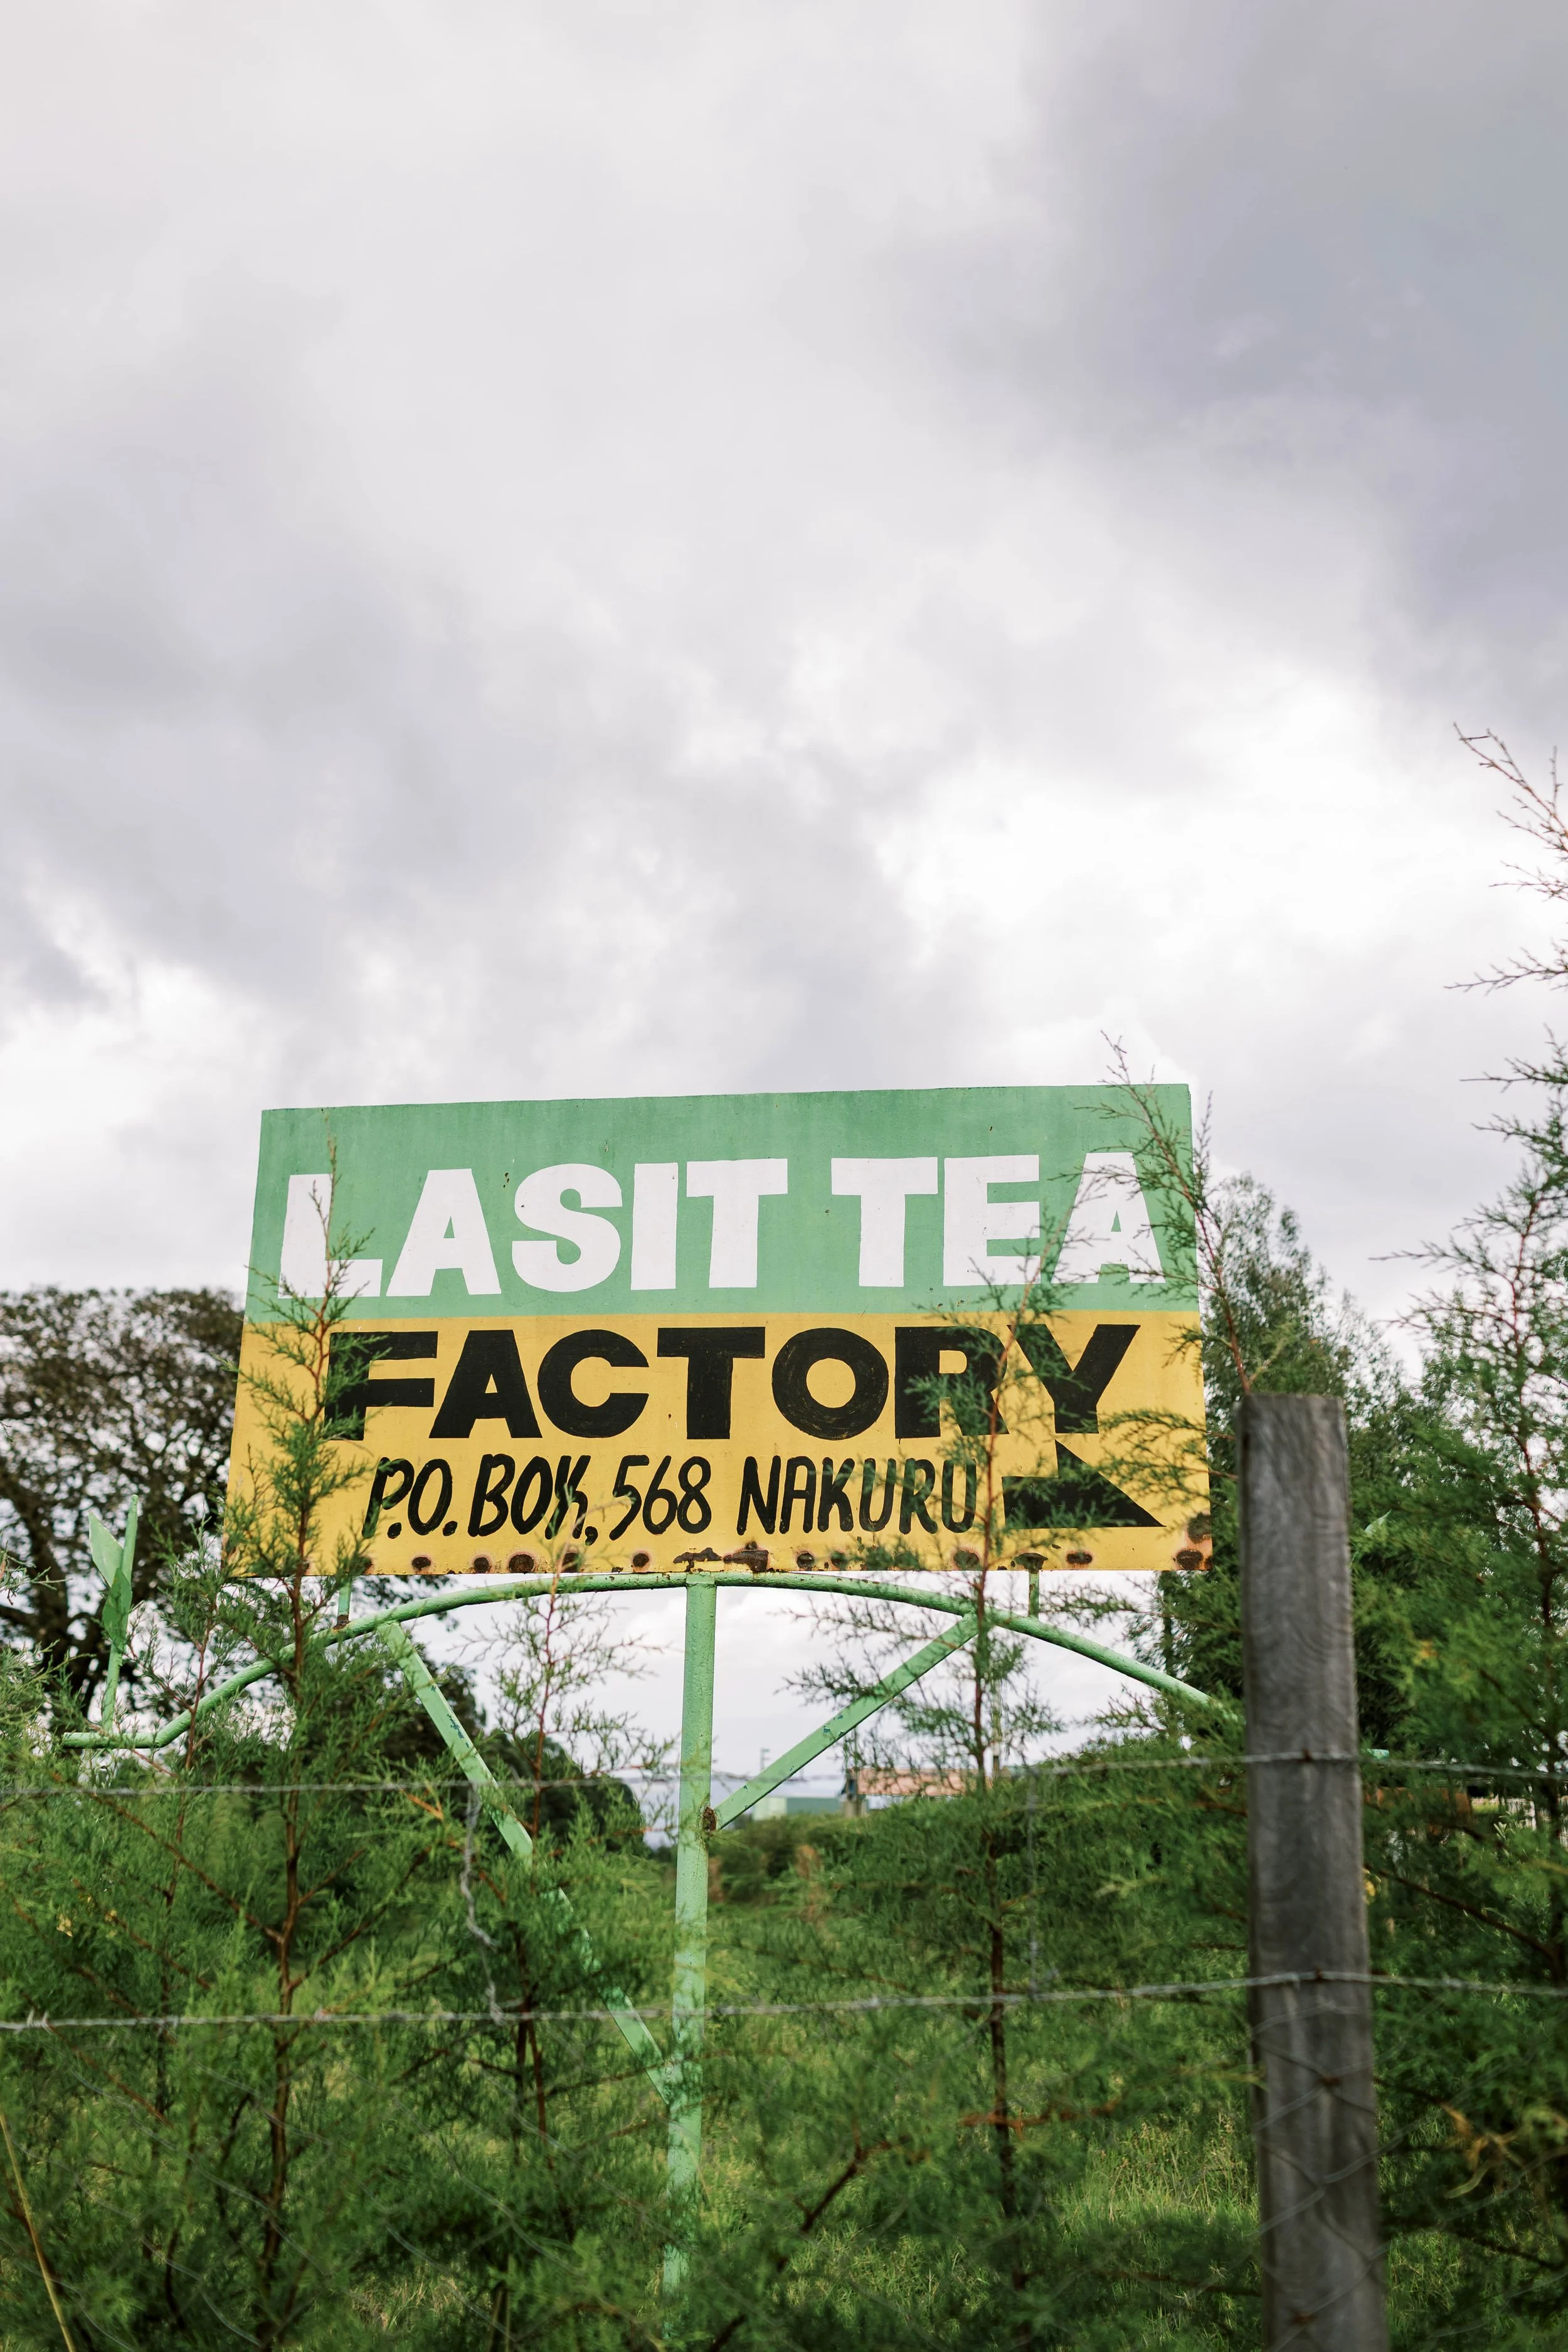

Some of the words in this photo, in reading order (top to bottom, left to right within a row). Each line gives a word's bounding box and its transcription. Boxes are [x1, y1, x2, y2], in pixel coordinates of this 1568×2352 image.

[278, 1159, 788, 1299] LASIT
[830, 1152, 1166, 1287] TEA
[324, 1325, 1141, 1441] FACTORY
[361, 1456, 458, 1539] P.O.
[608, 1454, 712, 1541] 568
[736, 1455, 977, 1535] NAKURU
